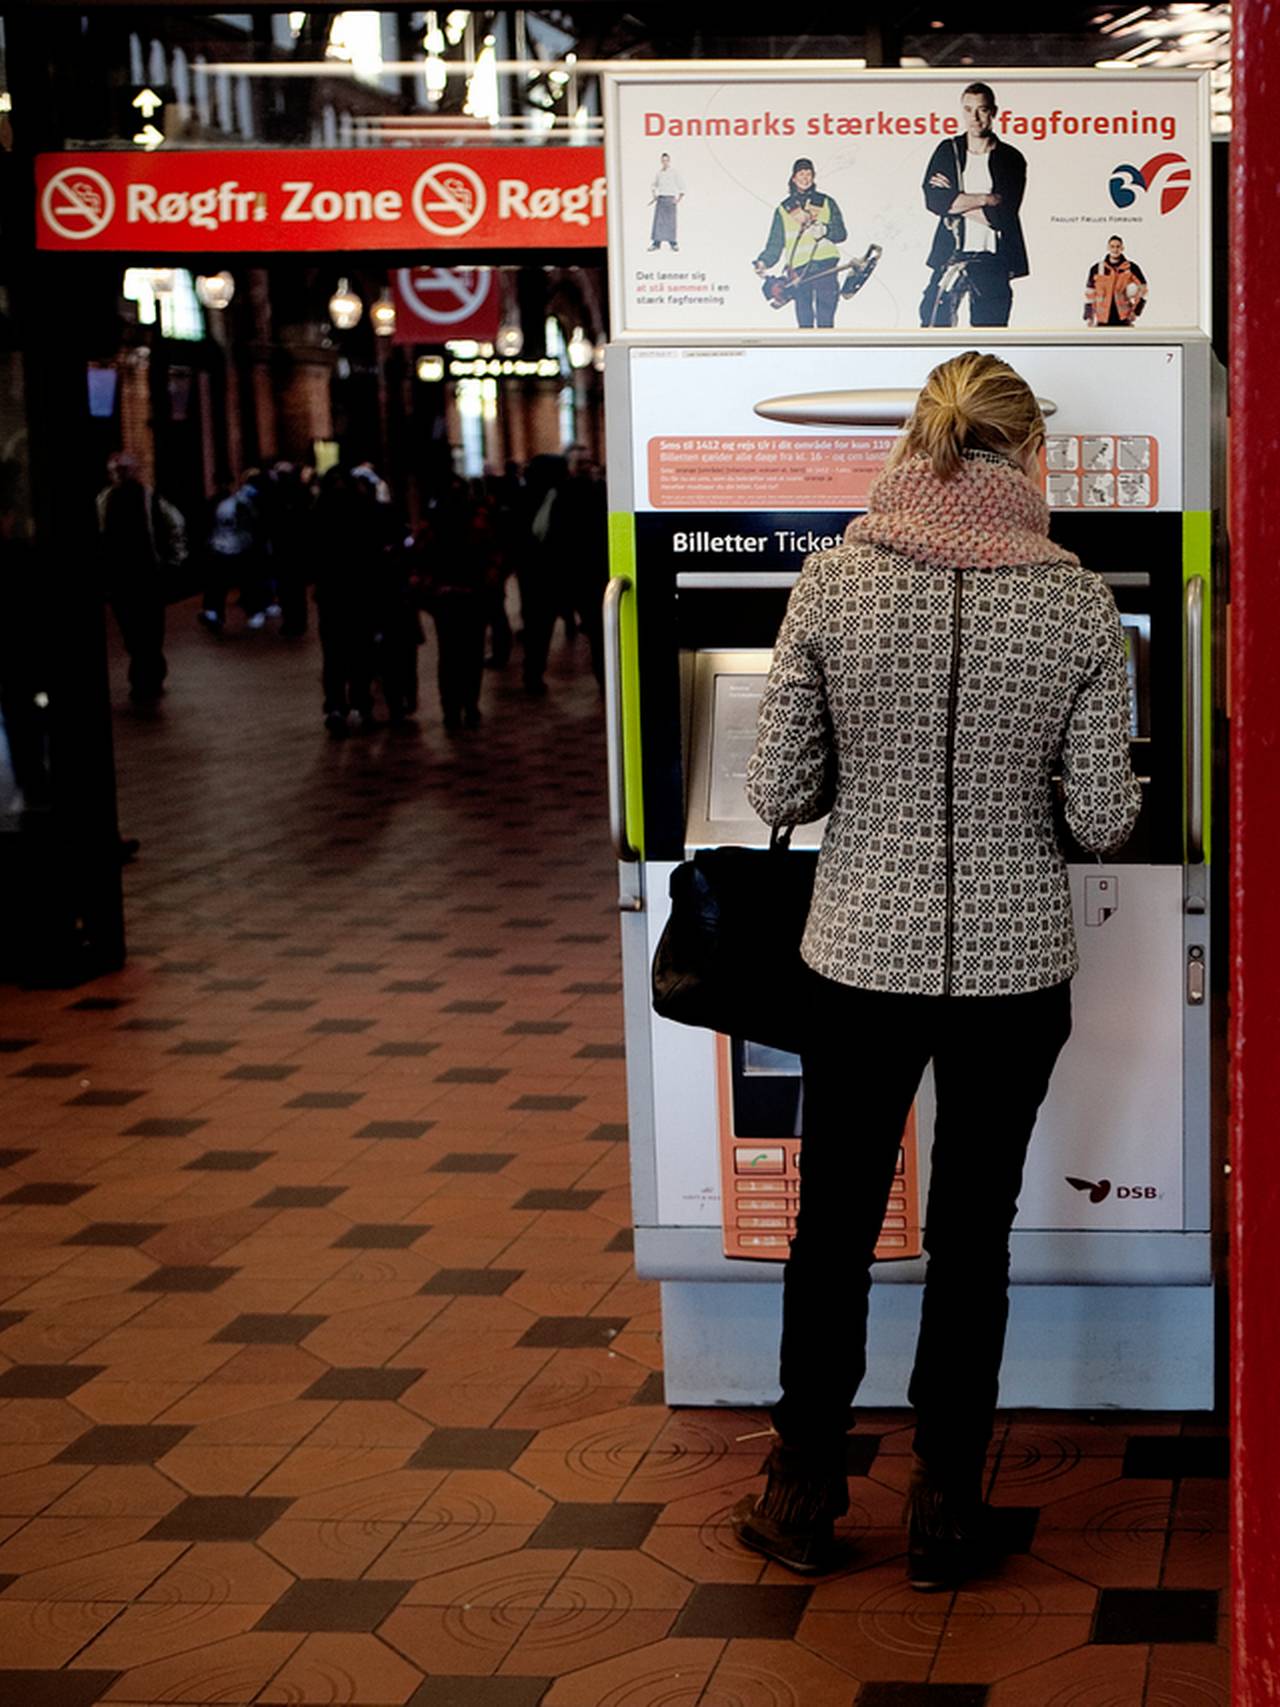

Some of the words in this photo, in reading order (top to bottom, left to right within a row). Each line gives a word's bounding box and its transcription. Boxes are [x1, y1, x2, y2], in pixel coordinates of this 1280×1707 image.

[644, 112, 796, 137] Danmarks
[806, 111, 960, 136] stærkeste
[998, 110, 1176, 140] fagforening
[281, 181, 402, 222] Zone
[498, 177, 607, 227] Røgf
[636, 271, 654, 281] Det
[691, 271, 706, 282] sig
[1166, 353, 1174, 364] 7
[672, 531, 768, 552] Billetter
[774, 531, 846, 552] Ticket
[1116, 1186, 1158, 1199] DSB
